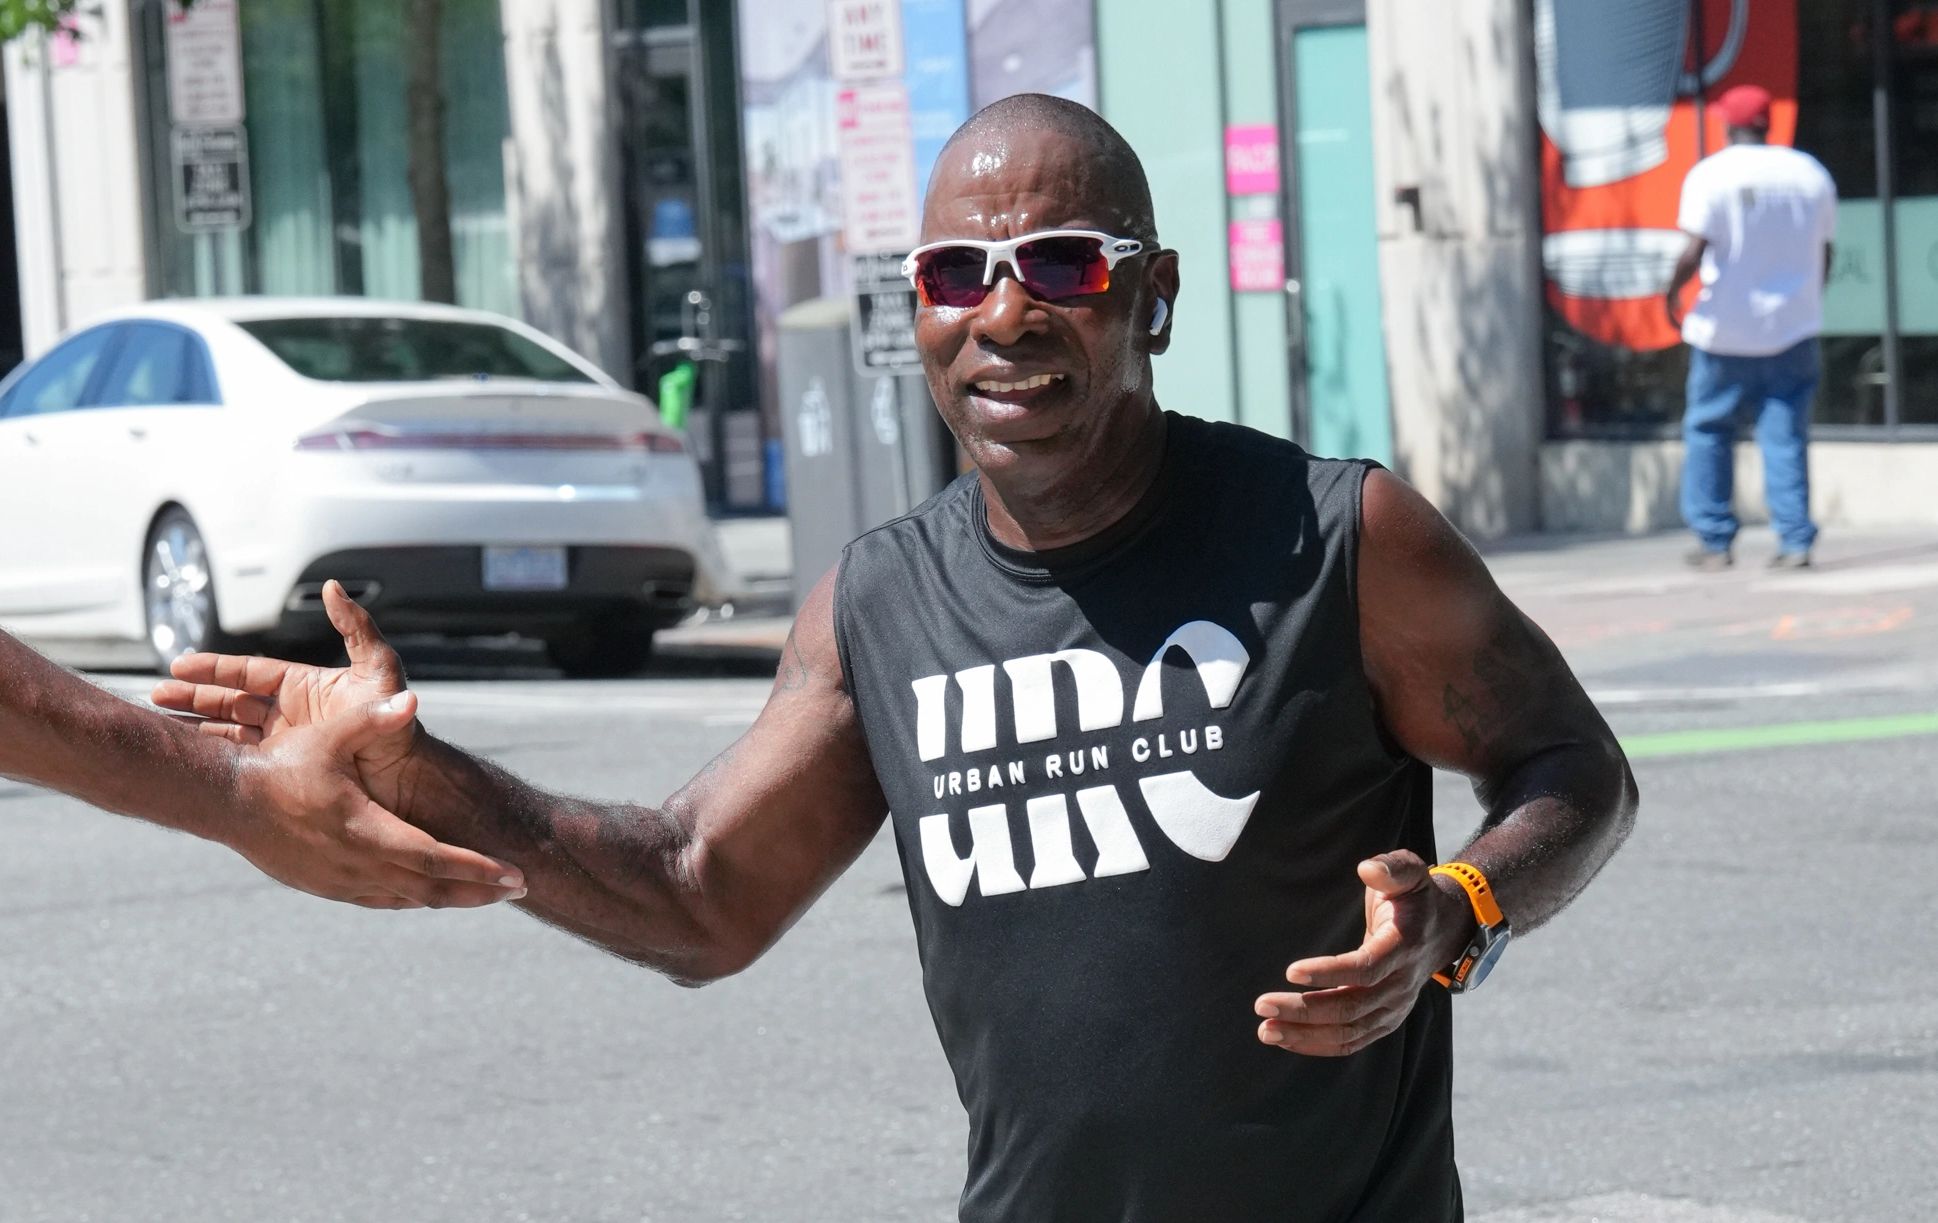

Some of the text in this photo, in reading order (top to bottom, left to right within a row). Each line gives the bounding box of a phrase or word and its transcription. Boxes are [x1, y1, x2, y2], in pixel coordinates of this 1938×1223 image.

[933, 724, 1224, 800] URBAN RUN CLUB
